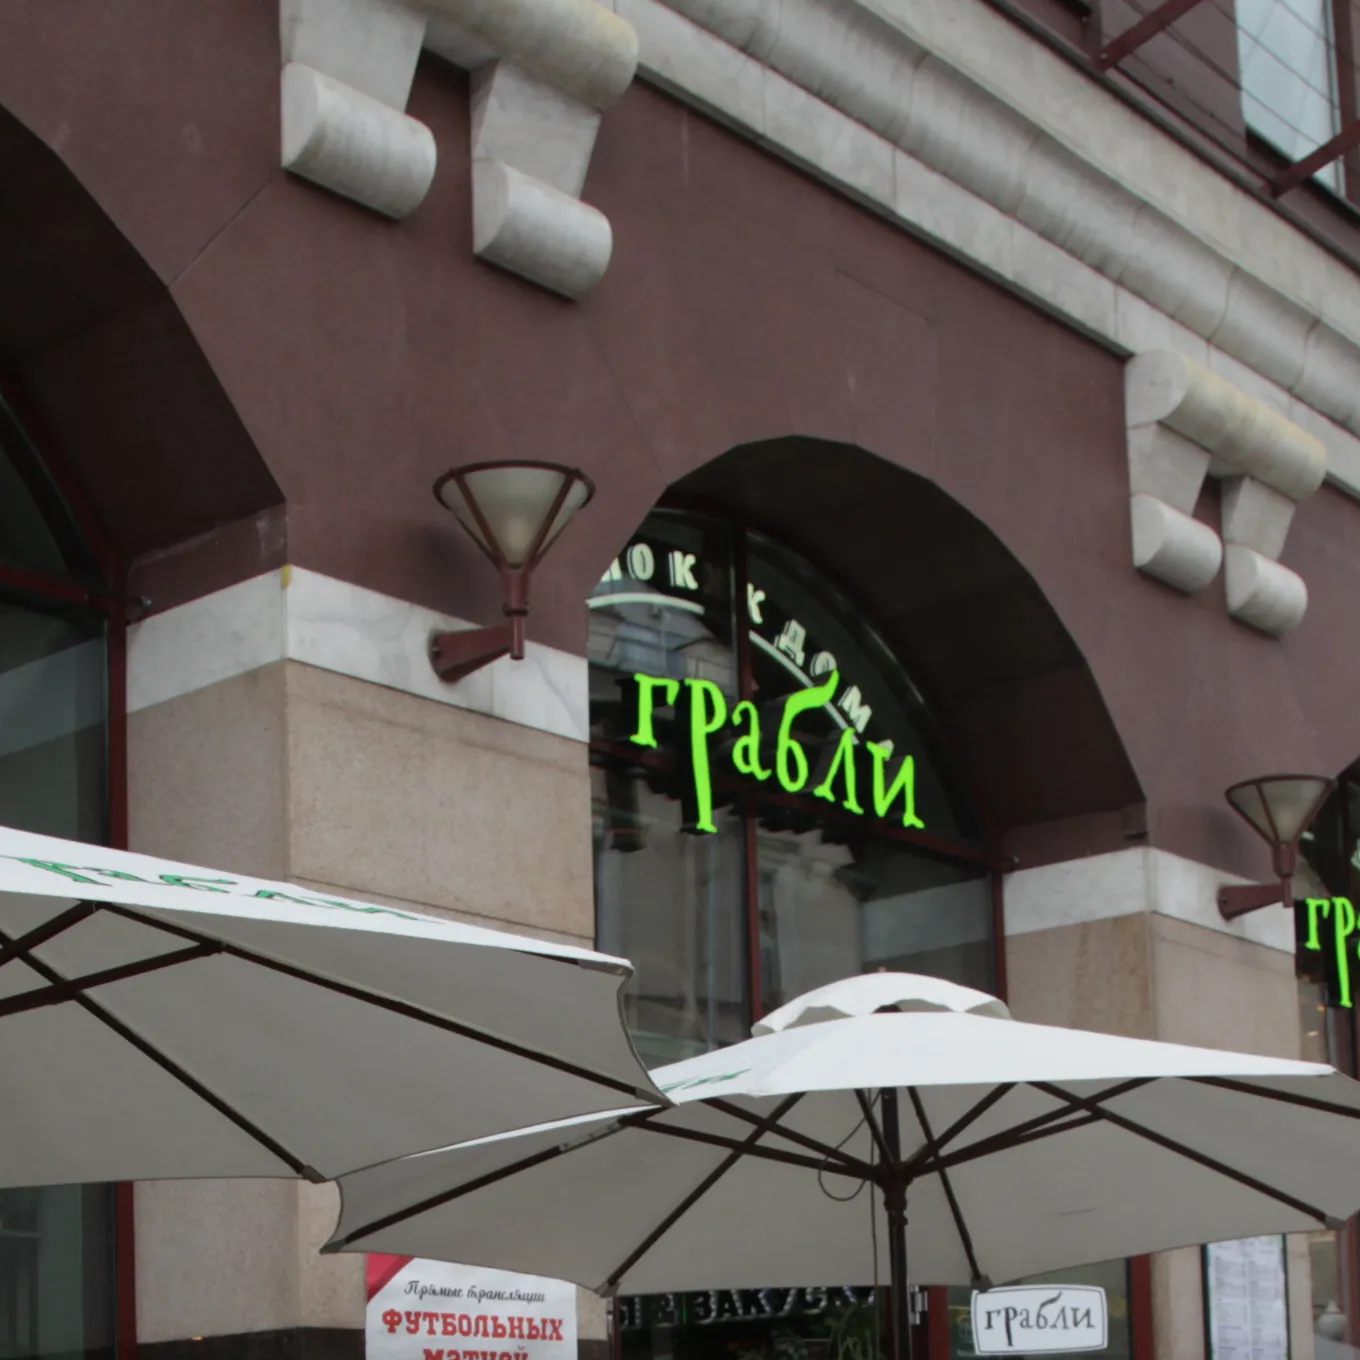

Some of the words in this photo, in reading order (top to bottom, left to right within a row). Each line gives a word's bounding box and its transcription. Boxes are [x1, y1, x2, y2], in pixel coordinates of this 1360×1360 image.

[403, 1280, 464, 1300] Прямые
[466, 1284, 546, 1304] трансляции
[381, 1308, 564, 1341] ФУТБОЛЬНЫХ
